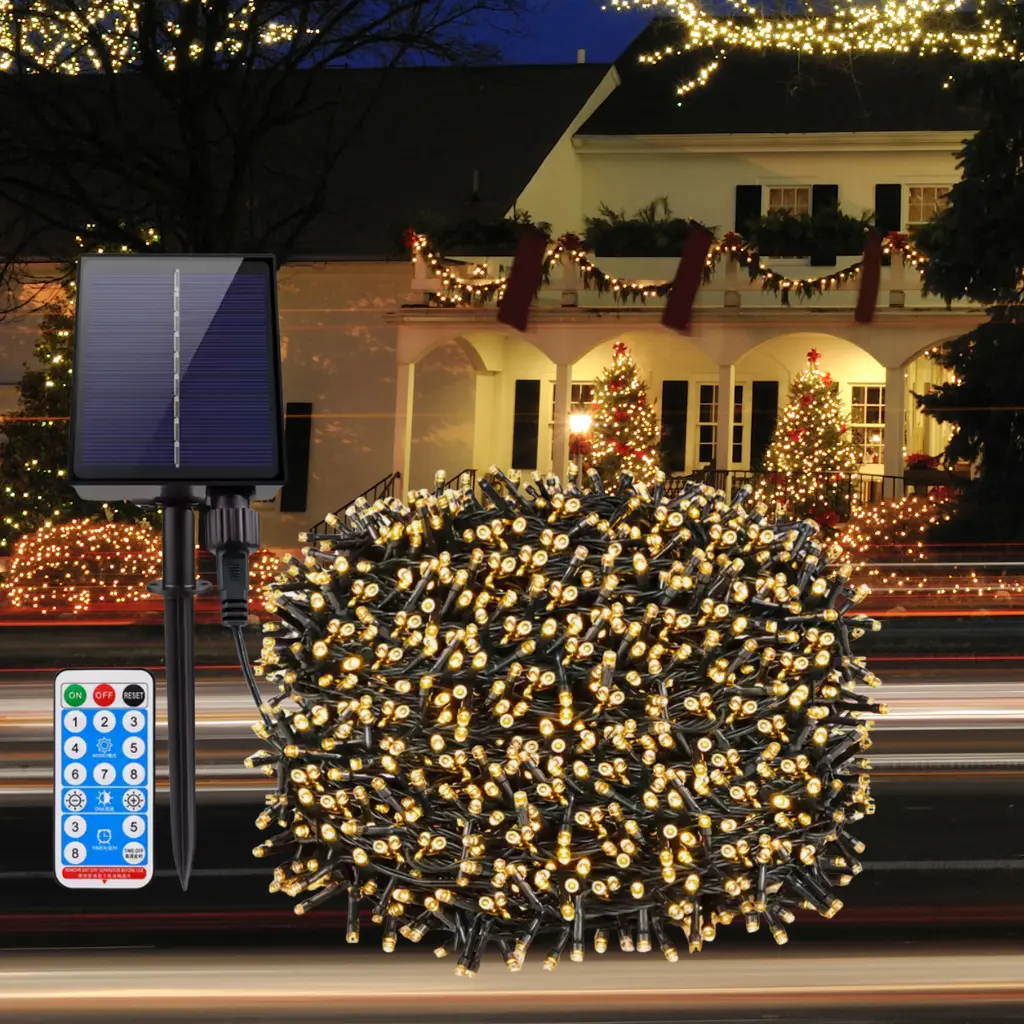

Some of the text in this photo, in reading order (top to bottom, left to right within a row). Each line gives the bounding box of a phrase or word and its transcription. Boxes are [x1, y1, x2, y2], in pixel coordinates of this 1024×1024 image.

[124, 691, 144, 699] RESET
[72, 716, 78, 727] 1
[101, 716, 109, 727] 2
[130, 716, 138, 727] 3
[71, 743, 79, 753] 4
[130, 742, 138, 753] 5
[71, 769, 79, 780] 6
[101, 769, 108, 779] 7
[130, 769, 138, 780] 8
[71, 821, 79, 832] 3
[130, 821, 138, 832] 5
[71, 848, 79, 859] 8
